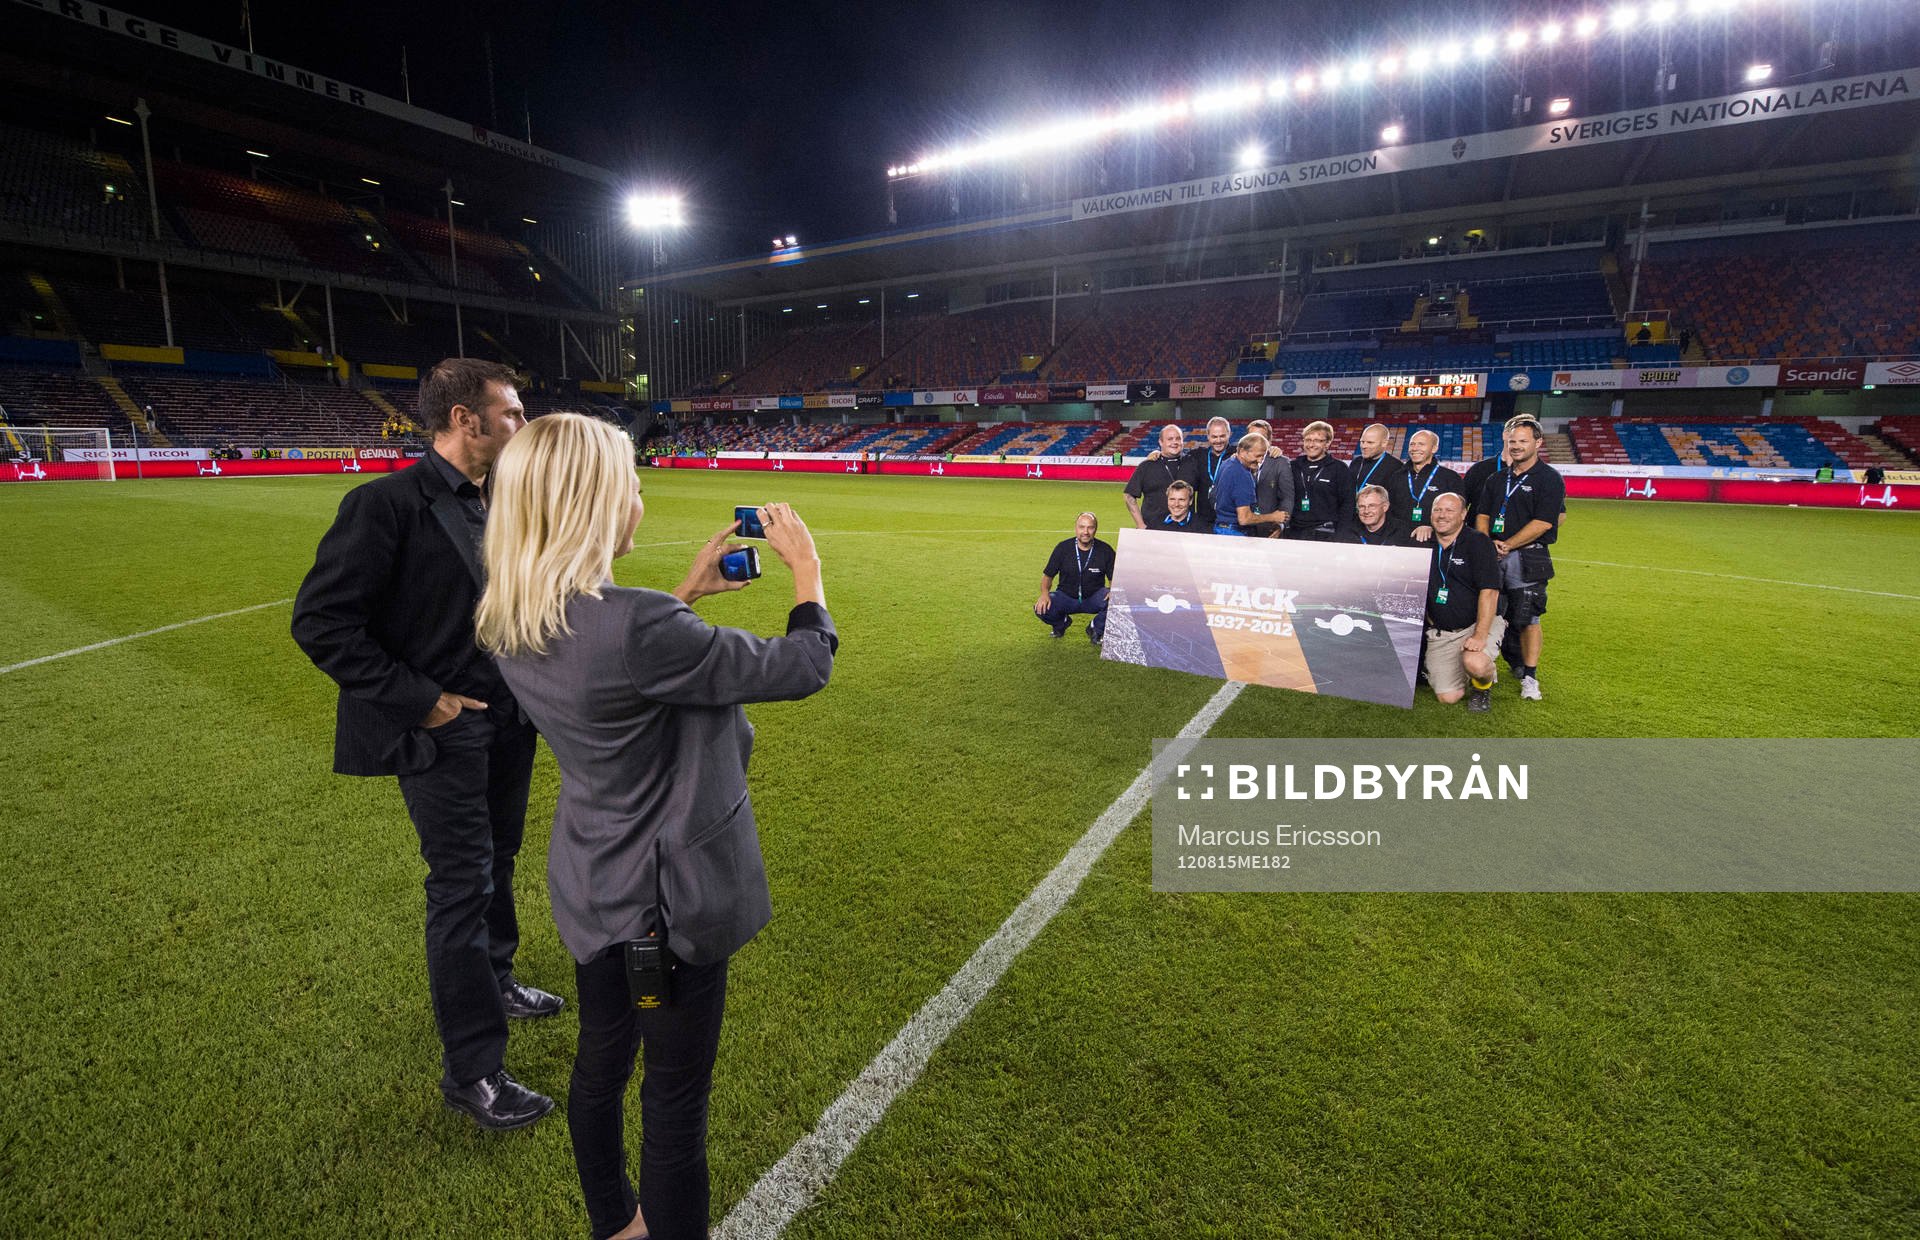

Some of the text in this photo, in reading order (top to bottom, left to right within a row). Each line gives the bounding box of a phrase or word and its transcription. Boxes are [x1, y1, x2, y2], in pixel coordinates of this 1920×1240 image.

[22, 0, 366, 105] RIGE VINNER
[1550, 76, 1909, 144] SVERIGES NATIONALARENA
[1082, 186, 1172, 214] VÄLKOMMEN
[1180, 184, 1205, 199] TILL
[1299, 156, 1377, 181] STADION
[1378, 376, 1415, 387] SWEDEN
[1439, 374, 1477, 385] BRAZIL
[1639, 370, 1680, 382] SPORT
[1786, 368, 1858, 381] Scandic
[1015, 390, 1036, 400] Malaco
[1179, 385, 1205, 394] SPORT
[1219, 384, 1260, 394] Scandic
[1388, 386, 1462, 397] 0 90:00 3
[953, 392, 969, 402] ICA
[359, 449, 399, 459] GEVALIA
[1211, 582, 1299, 613] TACK
[1206, 613, 1295, 637] 1937-2012
